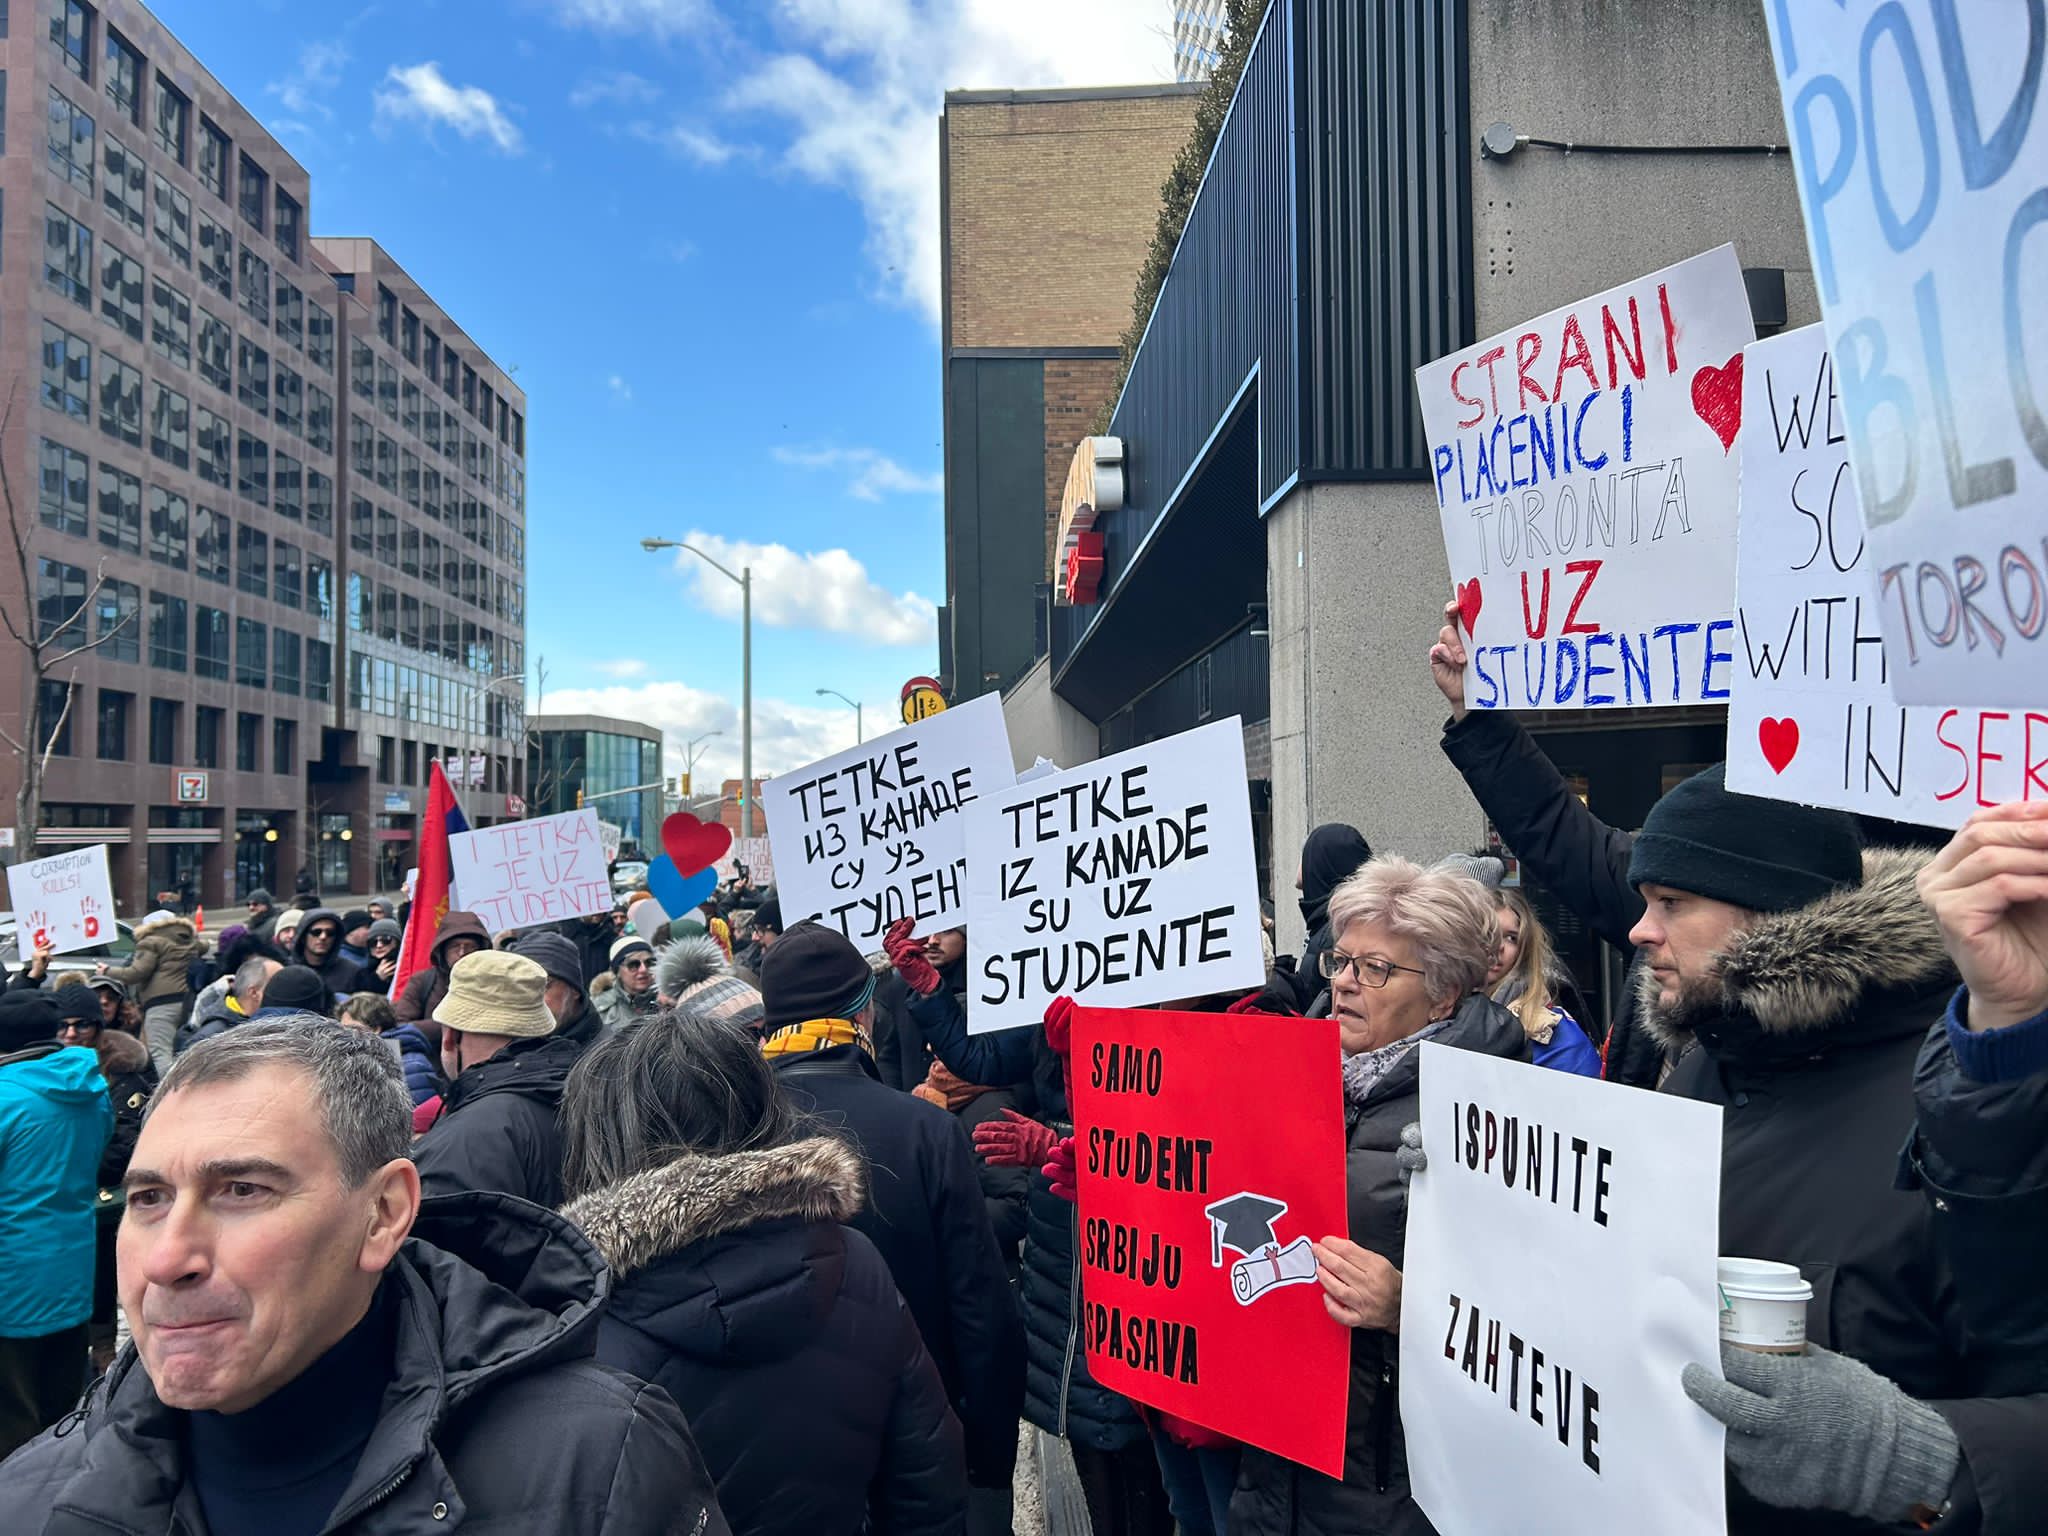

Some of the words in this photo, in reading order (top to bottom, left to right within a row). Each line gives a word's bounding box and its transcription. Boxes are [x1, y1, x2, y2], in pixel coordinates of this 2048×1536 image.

[1451, 283, 1678, 429] STRANI
[1766, 352, 1845, 453] WE
[1470, 457, 1692, 574] TORONTA
[1520, 560, 1603, 640] UZ
[1739, 596, 1886, 684] WITH
[1879, 537, 2048, 666] TORO
[1475, 620, 1733, 709] STUDENTE
[789, 741, 925, 822] ТЕТКЕ
[1844, 703, 1906, 797] IN
[490, 816, 594, 856] TETKA
[804, 822, 846, 864] ИЗ
[860, 767, 979, 847] КАНАДЕ
[1001, 765, 1153, 848] TETKE
[31, 854, 91, 879] CORRUPTION
[494, 858, 531, 893] JE
[540, 850, 584, 885] UZ
[831, 858, 864, 890] СУ
[885, 840, 925, 875] УЗ
[1001, 857, 1037, 901] IZ
[1066, 803, 1208, 888] KANADE
[468, 880, 611, 929] STUDENTE
[1024, 898, 1070, 933] SU
[1103, 878, 1152, 920] UZ
[981, 905, 1235, 1005] STUDENTE
[1091, 1042, 1162, 1097] SAMO
[1088, 1126, 1213, 1194] STUDENT
[1454, 1102, 1612, 1228] ISPUNITE
[1086, 1217, 1181, 1290] SRBIJU
[1085, 1301, 1199, 1384] SPASAVA
[1444, 1293, 1600, 1477] ZAHTEVE
